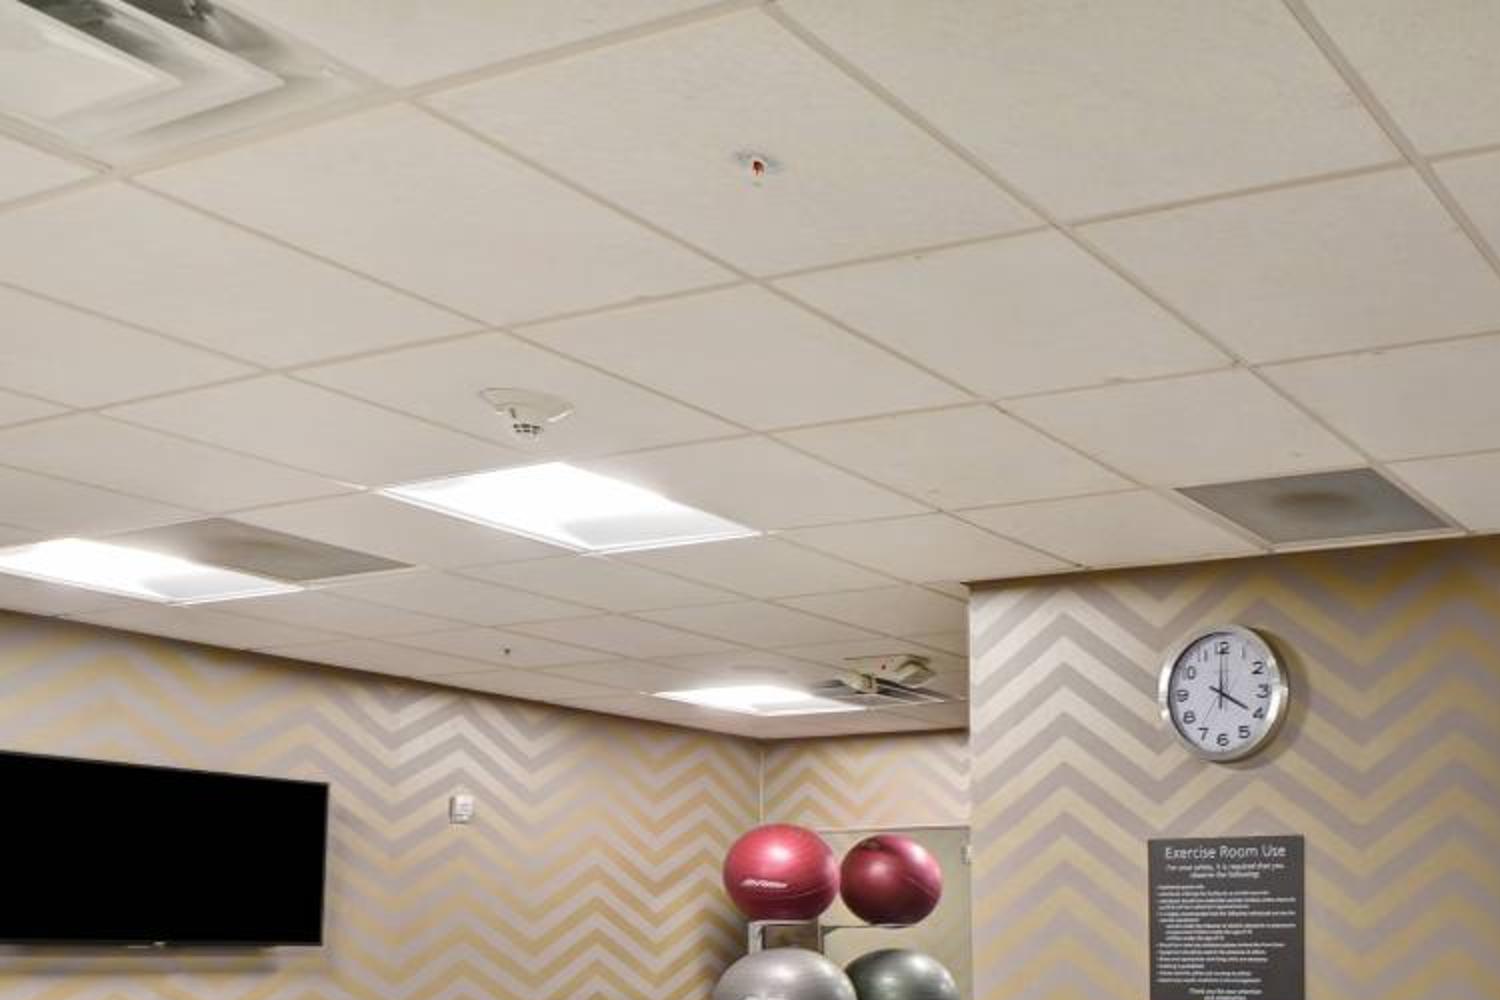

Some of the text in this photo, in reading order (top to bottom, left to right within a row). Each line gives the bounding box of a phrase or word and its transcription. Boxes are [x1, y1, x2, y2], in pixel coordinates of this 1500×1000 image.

[1252, 660, 1264, 675] 2
[1175, 689, 1189, 703] 9
[1255, 683, 1270, 699] 3
[1182, 709, 1196, 725] 8
[1252, 706, 1265, 720] 4
[1197, 726, 1209, 741] 7
[1238, 724, 1252, 739] 5
[1216, 732, 1230, 747] 6
[1164, 843, 1287, 860] Exercise Room Use
